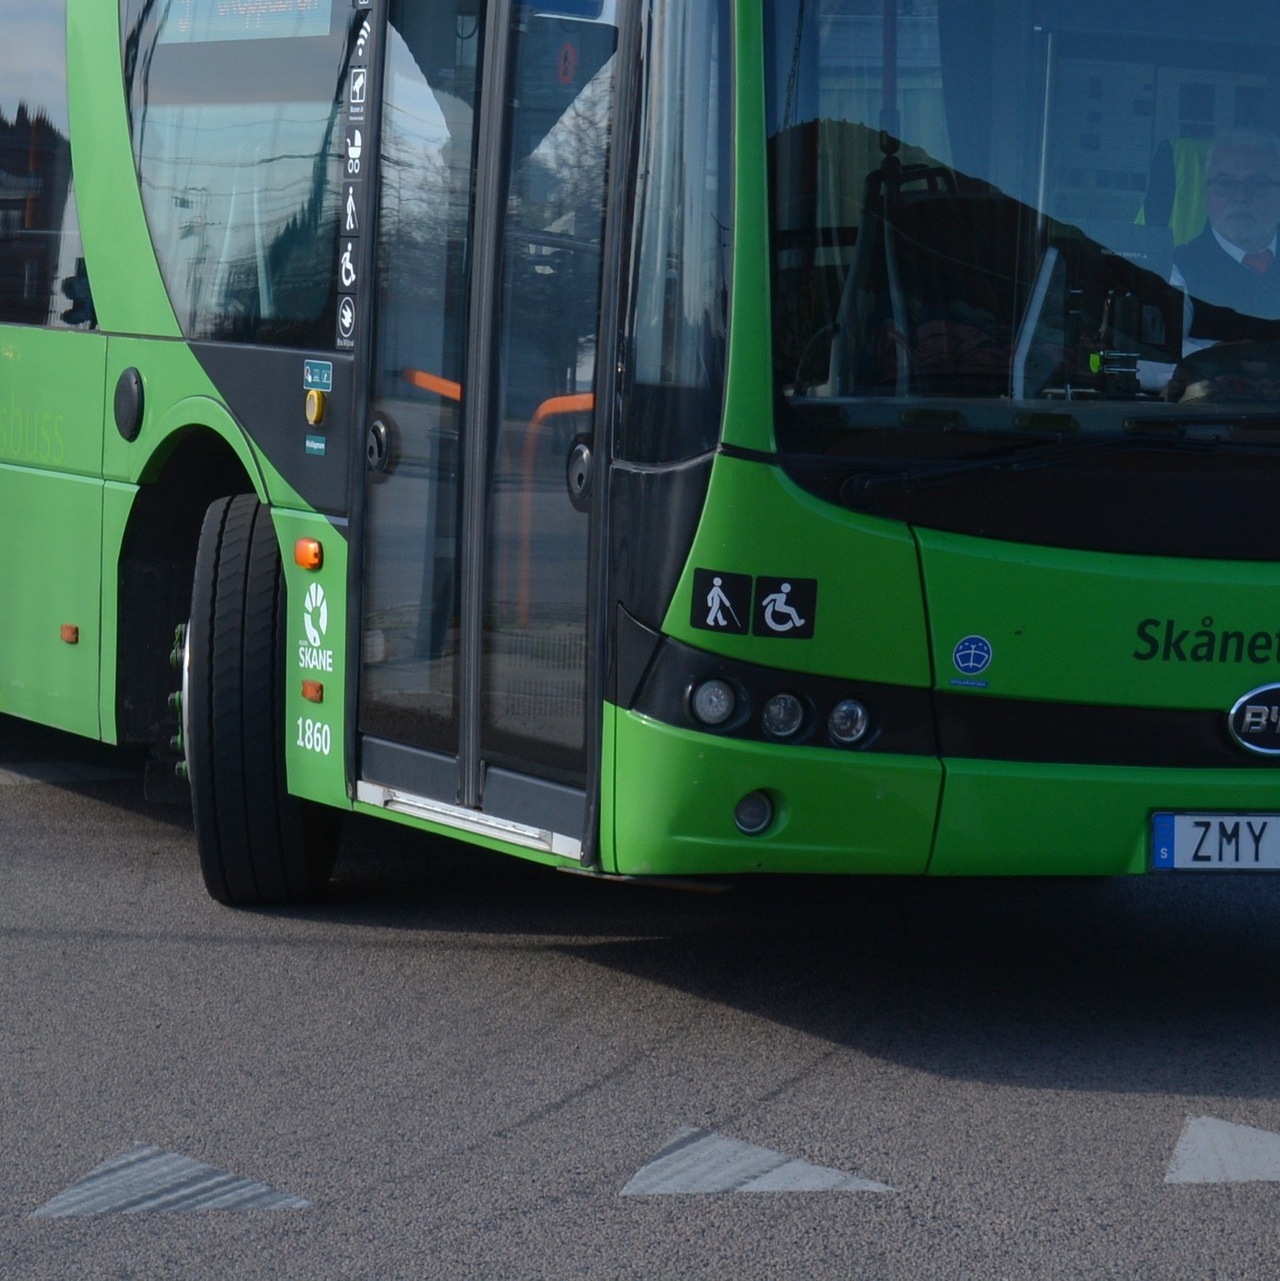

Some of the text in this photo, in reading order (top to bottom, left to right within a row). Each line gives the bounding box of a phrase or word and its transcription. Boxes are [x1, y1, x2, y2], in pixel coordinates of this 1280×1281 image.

[296, 716, 331, 756] 1860
[1159, 847, 1168, 860] S
[1191, 820, 1268, 863] ZMY
